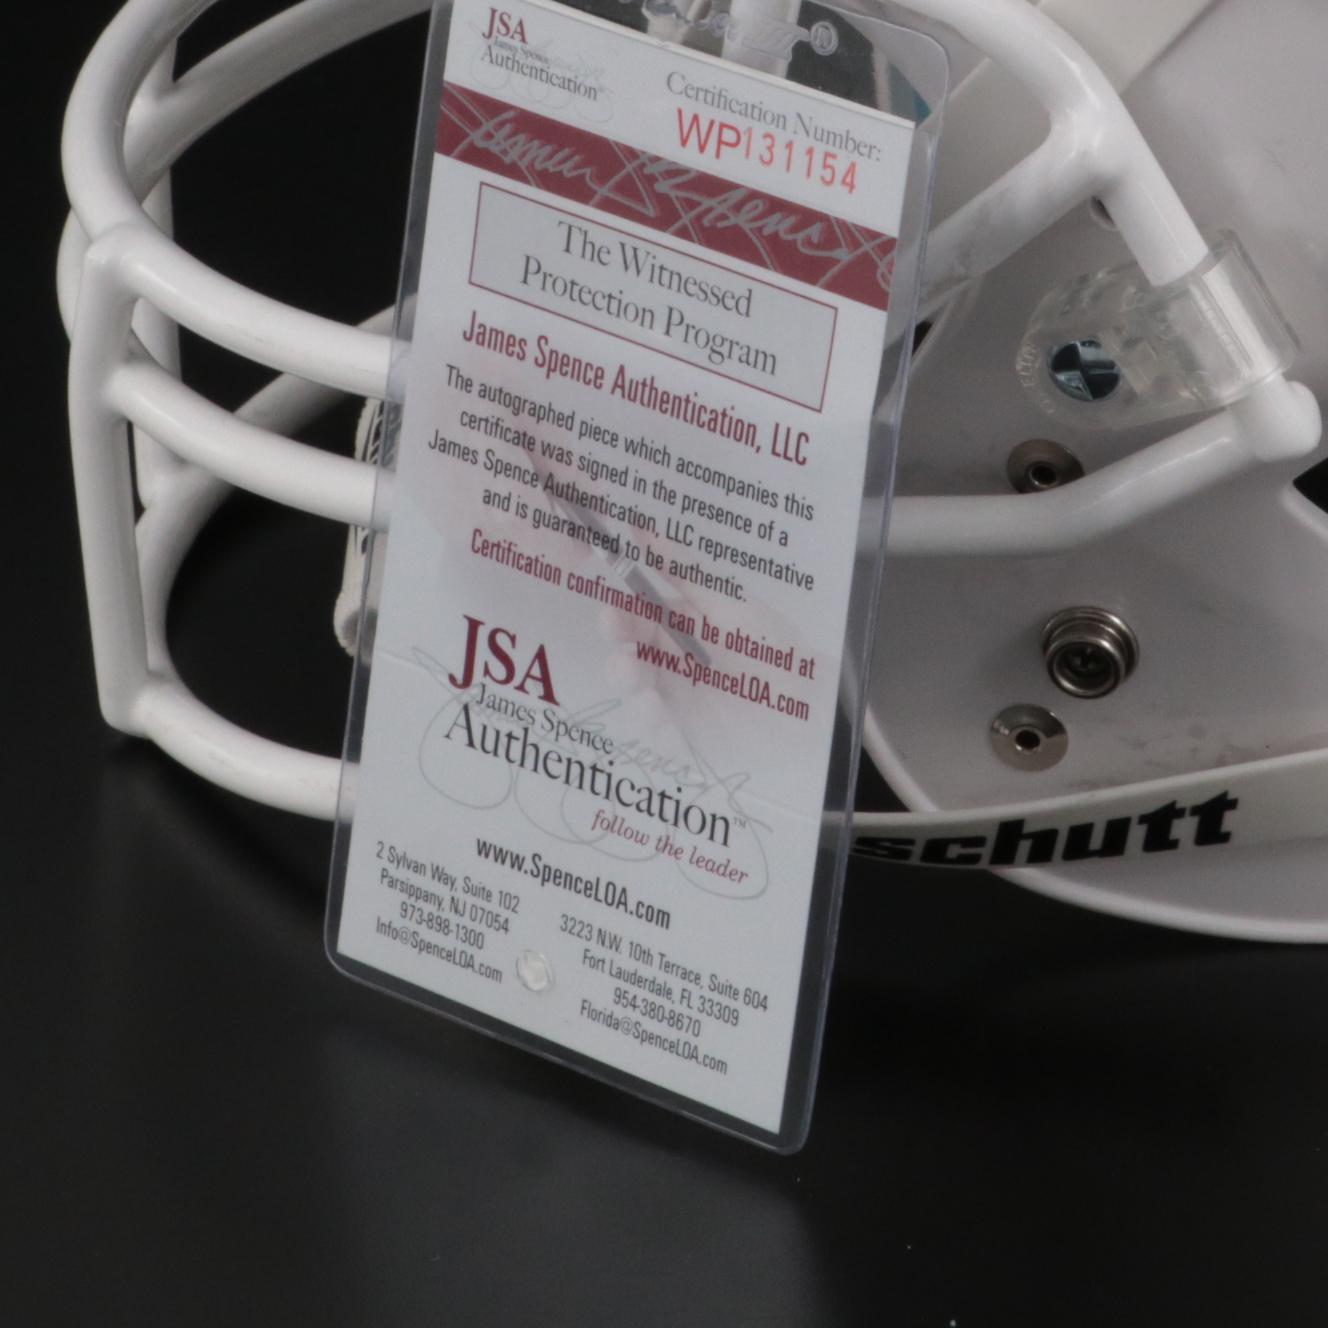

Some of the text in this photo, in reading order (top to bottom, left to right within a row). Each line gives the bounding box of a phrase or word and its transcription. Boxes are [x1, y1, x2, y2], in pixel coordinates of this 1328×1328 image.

[482, 7, 528, 44] JSA
[481, 45, 598, 101] Authentication
[666, 72, 881, 162] Certification Number:
[677, 107, 858, 194] WP131154
[557, 219, 753, 319] The Witnessed
[520, 254, 778, 376] Protection Program
[462, 311, 810, 467] James Spence Authentication, LLC
[445, 363, 814, 522] The autographed piece which accompanies this
[460, 409, 789, 547] certificate was signed in the presence of a
[428, 429, 814, 591] James Spence Authentication, LLC representative
[482, 486, 747, 603] and is guaranteed to be authentic.
[471, 528, 815, 680] Certification confirmation can be obtained at
[448, 614, 560, 706] JSA
[636, 640, 810, 721] www.SpenceLOA.com
[475, 682, 614, 755] James Spence
[445, 702, 732, 848] Authentication
[591, 809, 750, 885] follow the leader
[850, 790, 1239, 866] schutt
[376, 841, 521, 915] 2 Sylvan Way, Suite 102
[380, 869, 510, 936] Parsippany, NJ 07054
[477, 838, 671, 930] www.SpenceLOA.com
[376, 917, 503, 984] Info@SpenceLOA.com
[399, 900, 485, 951] 973-898-1300
[560, 914, 769, 1013] 3223 N.W. 10th Terrace, Suite 604
[582, 948, 740, 1027] Fort Lauderdale, FL 33309
[613, 986, 701, 1038] 954-380-8670
[580, 999, 728, 1076] Florida@SpenceLOA.com
